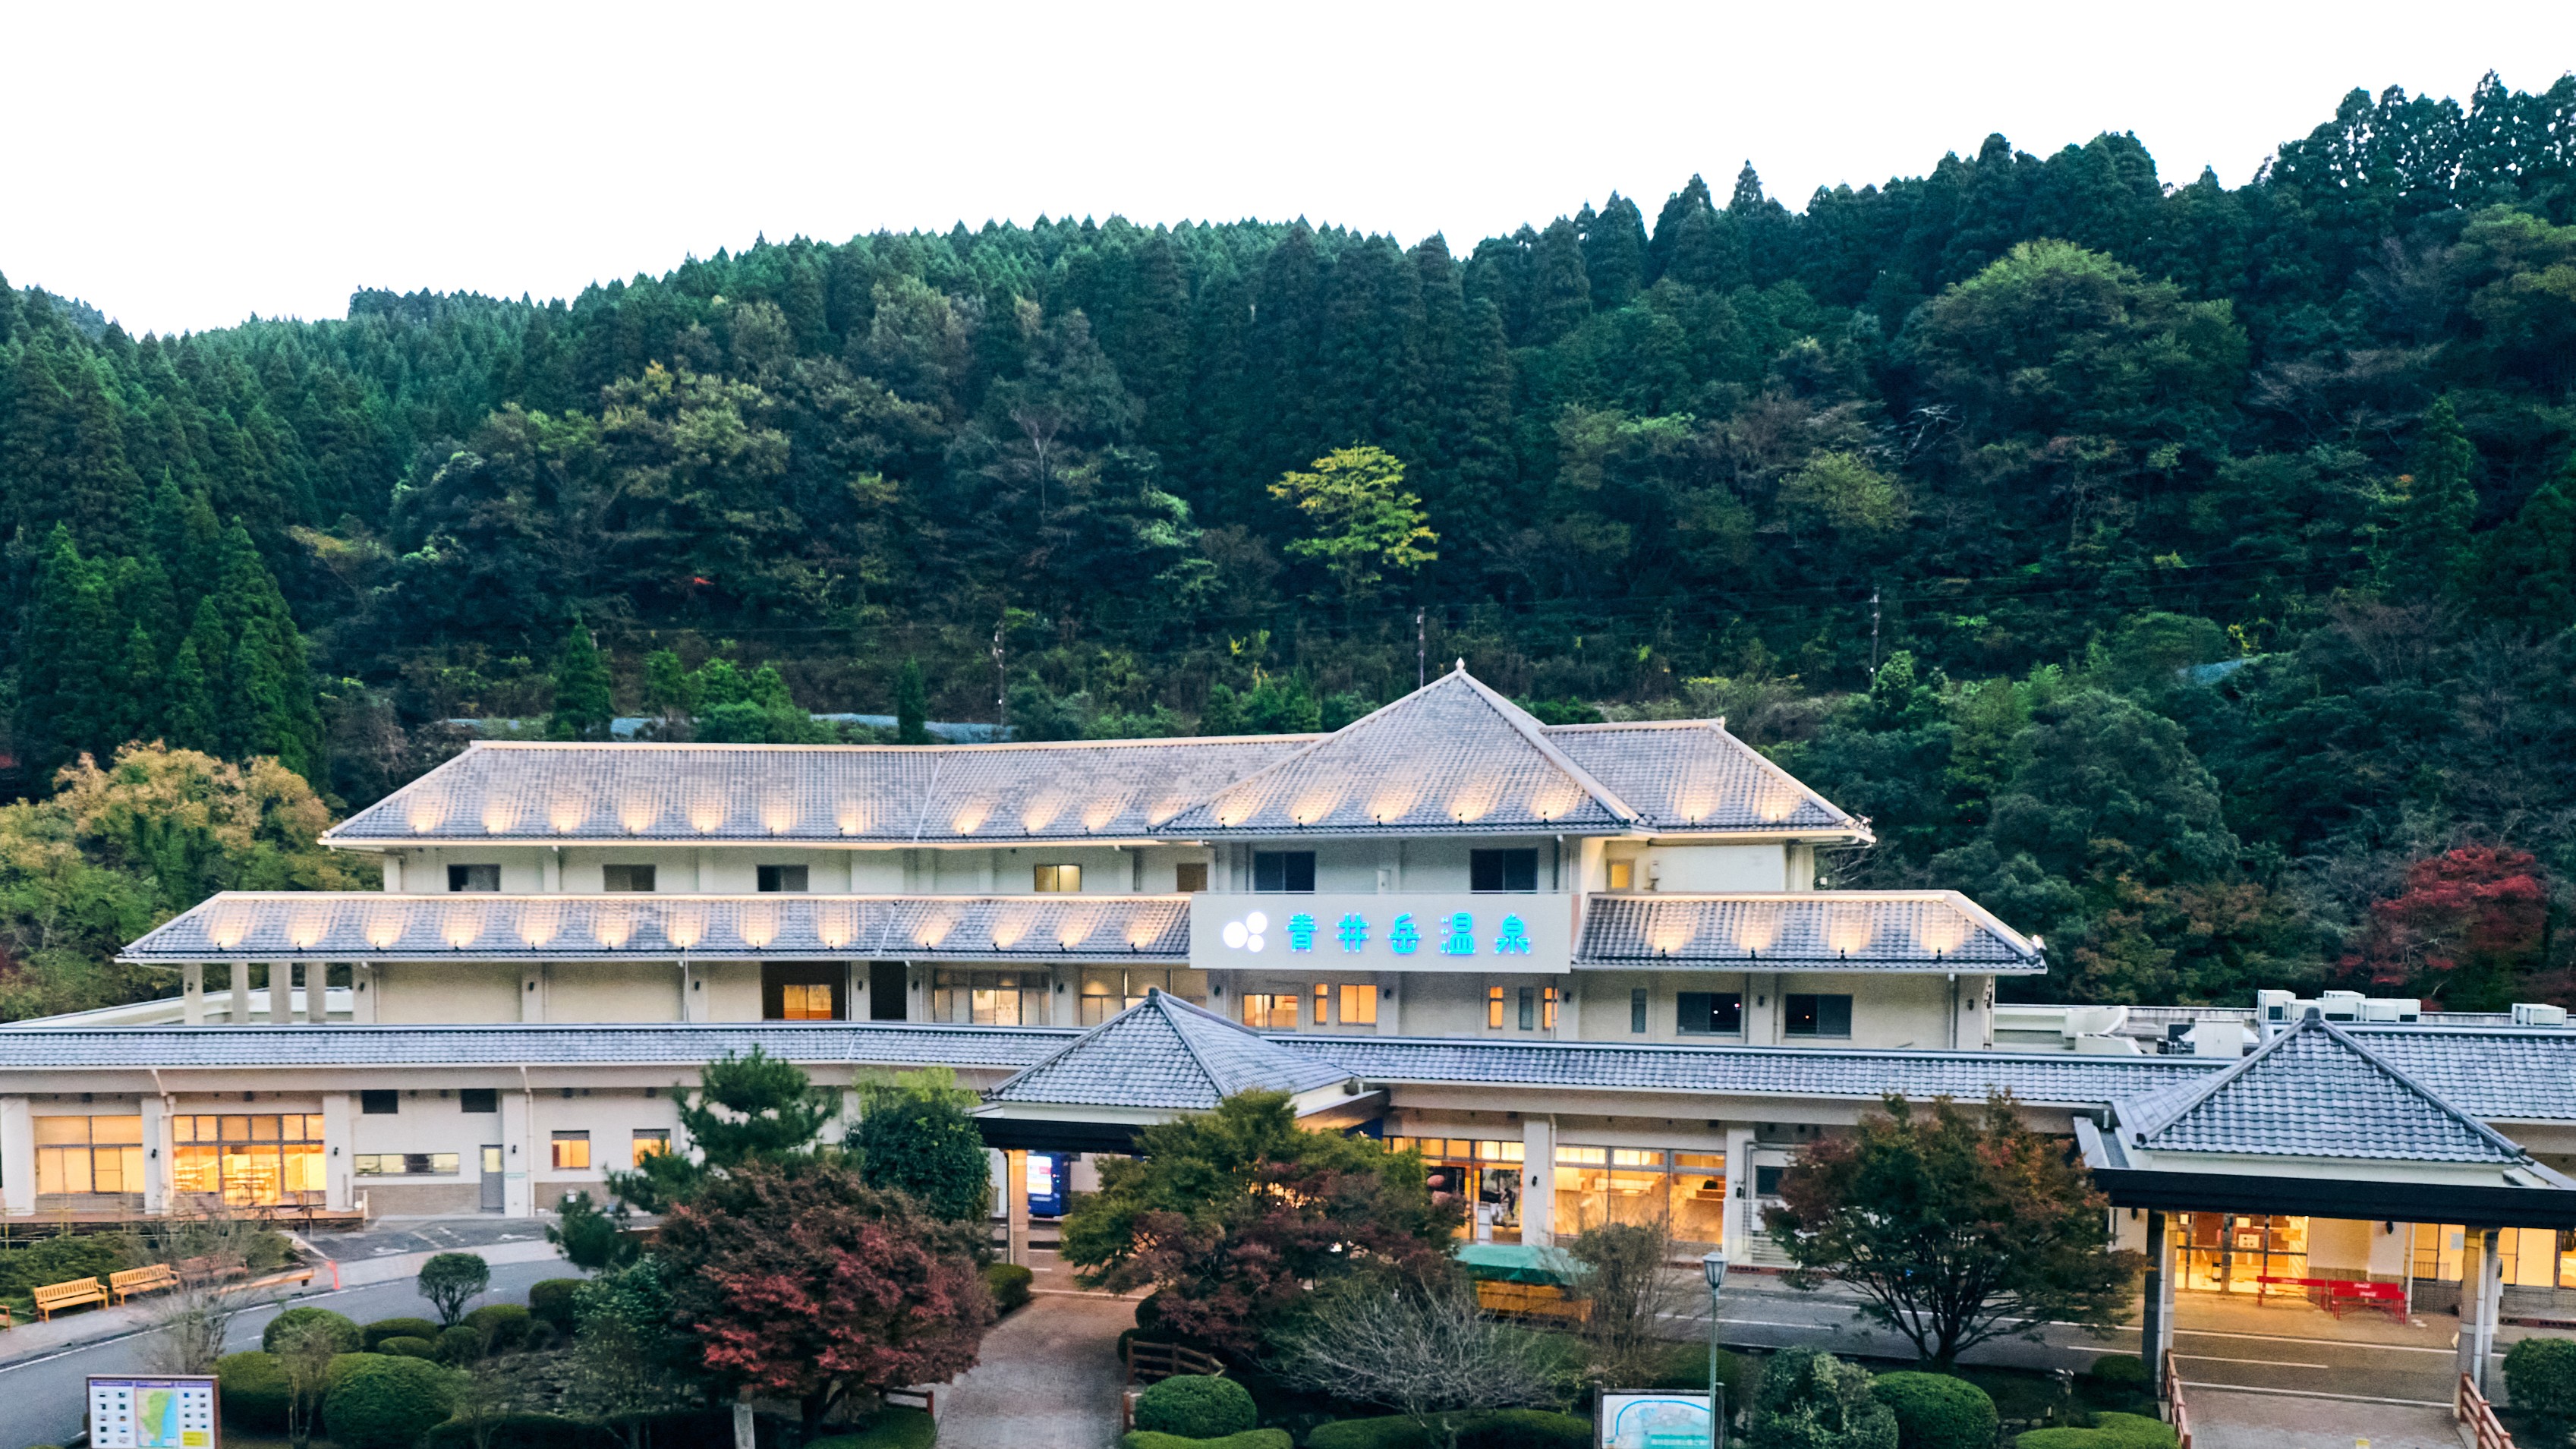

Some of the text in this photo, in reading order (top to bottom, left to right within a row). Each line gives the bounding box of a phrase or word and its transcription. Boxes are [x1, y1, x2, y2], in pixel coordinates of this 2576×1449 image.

[1286, 912, 1532, 955] 青井岳温泉
